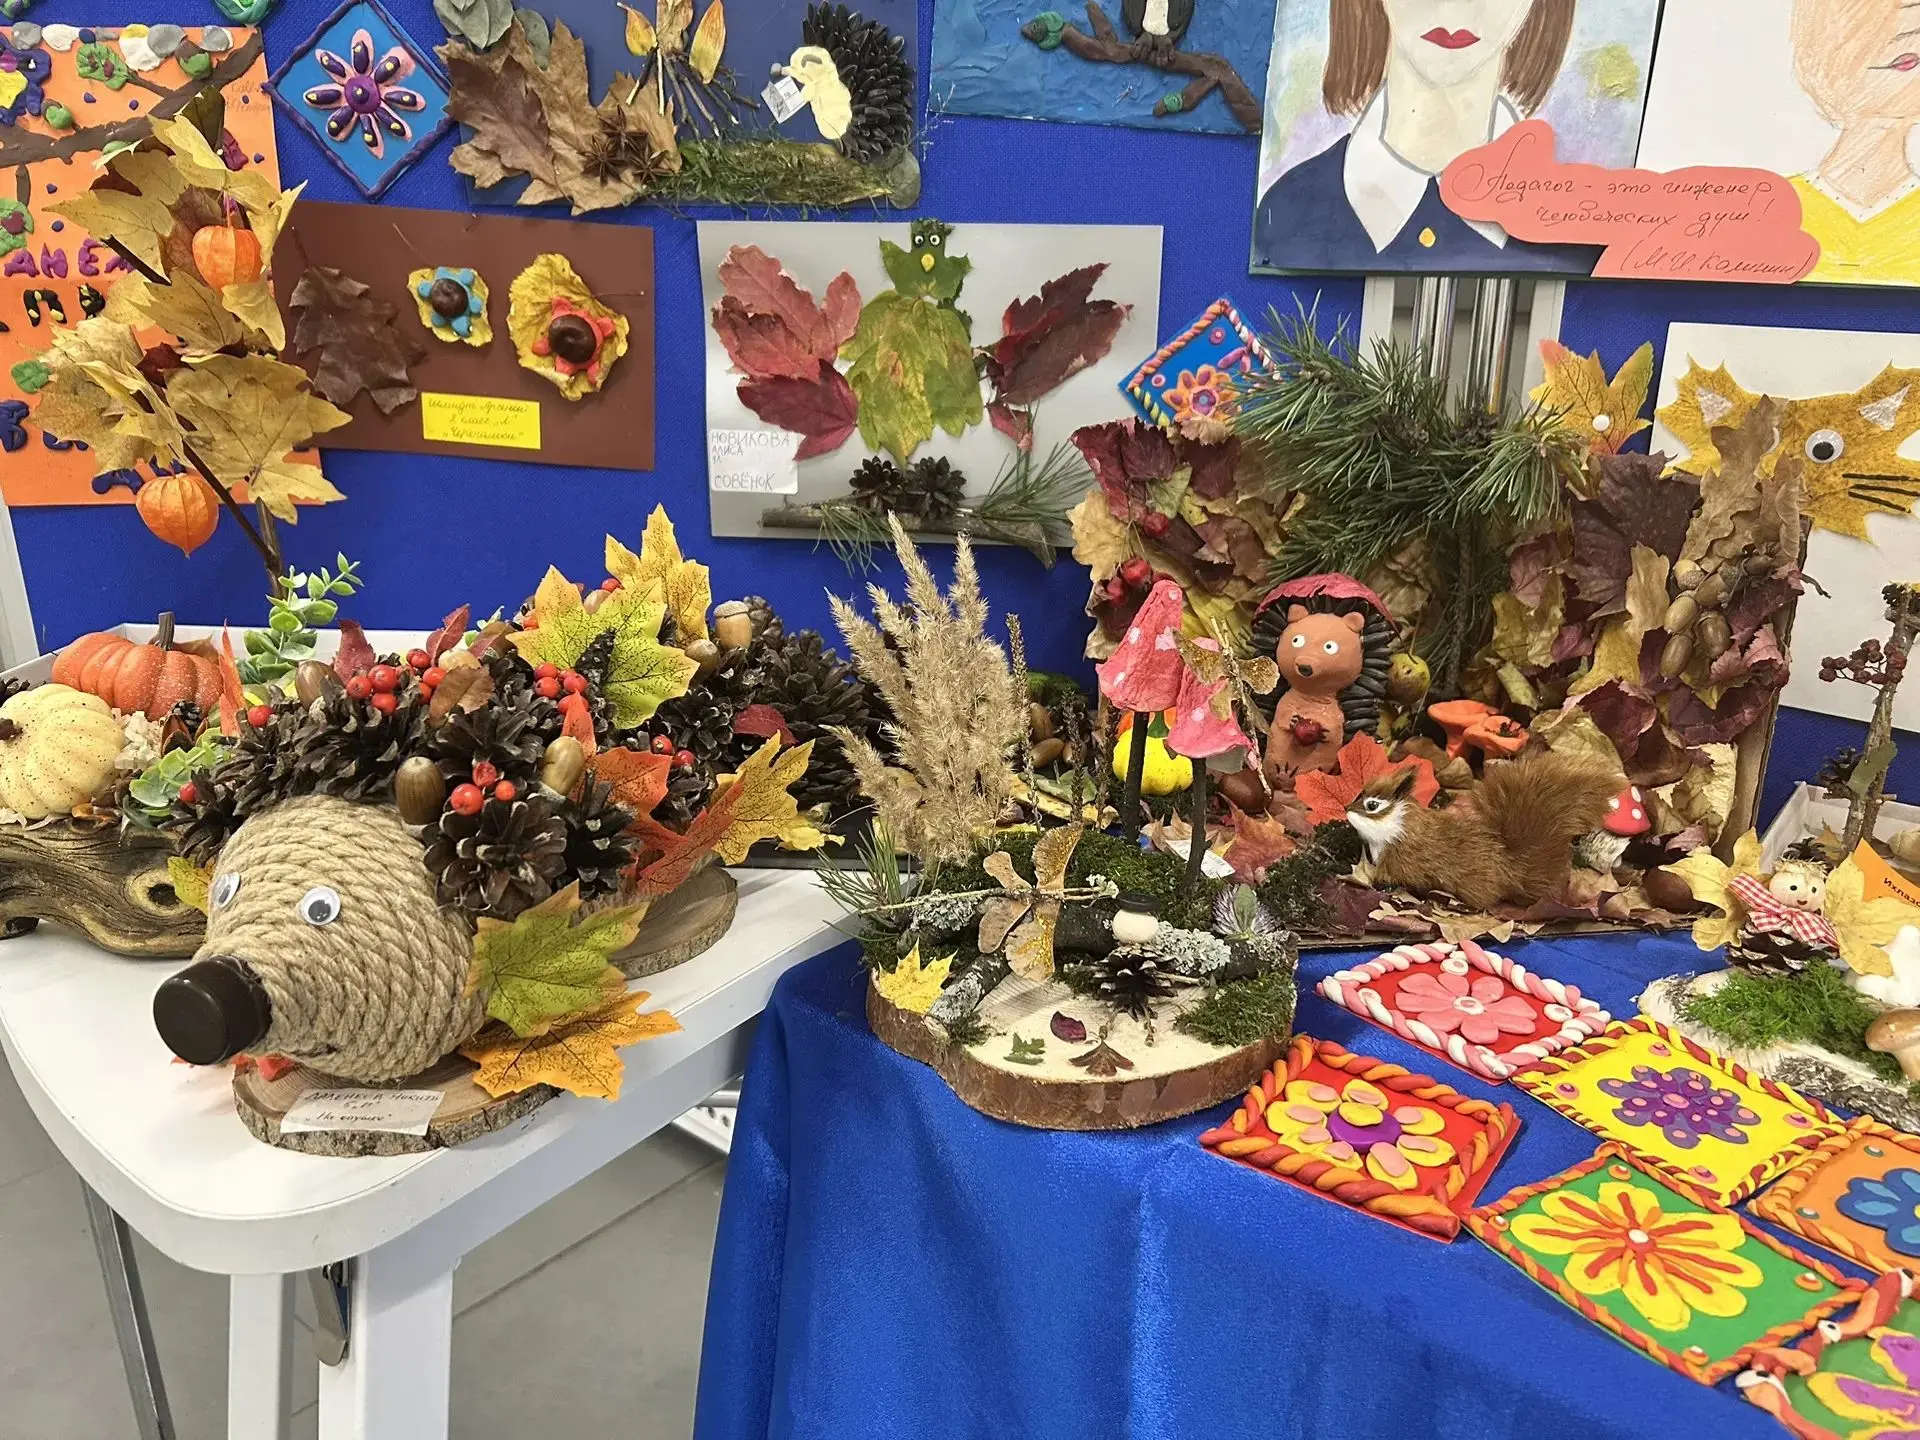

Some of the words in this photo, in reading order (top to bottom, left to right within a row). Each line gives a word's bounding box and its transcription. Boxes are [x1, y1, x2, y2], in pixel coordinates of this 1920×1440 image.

[1607, 180, 1651, 195] это
[1662, 180, 1775, 207] инженер
[711, 431, 790, 448] НОВИКОВА
[711, 445, 744, 456] АЛИСА
[714, 471, 776, 492] СОВЁНОК
